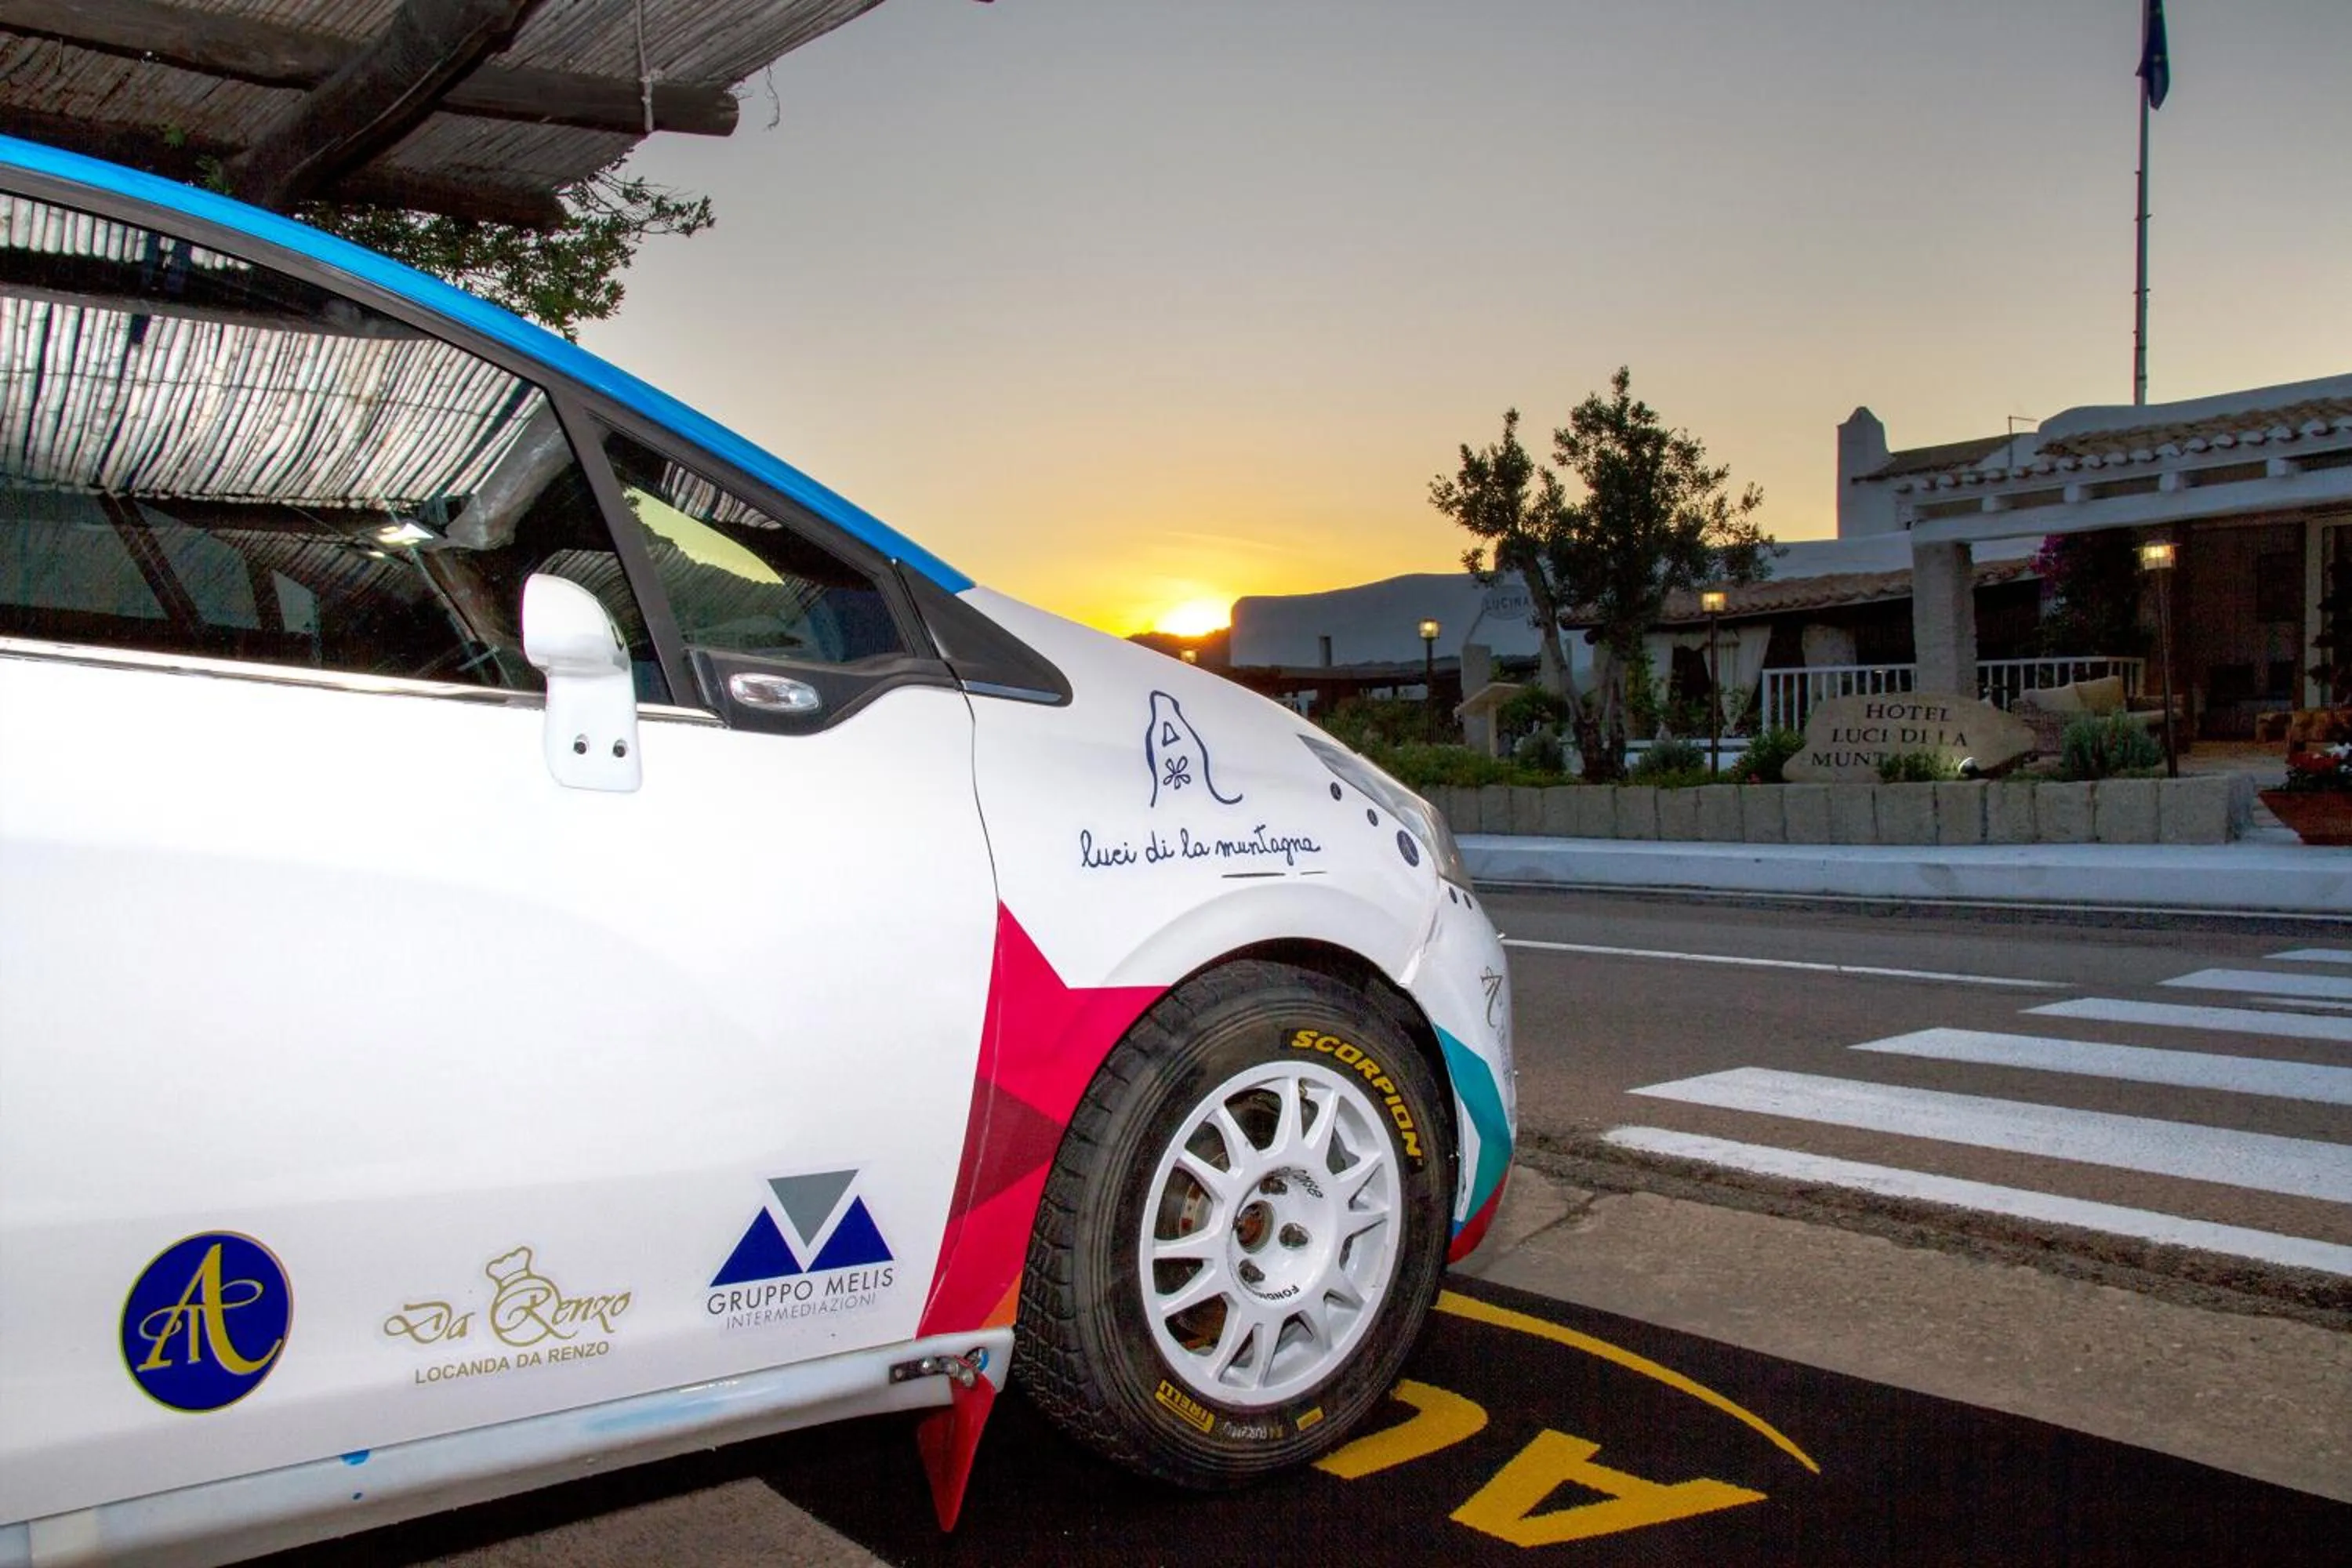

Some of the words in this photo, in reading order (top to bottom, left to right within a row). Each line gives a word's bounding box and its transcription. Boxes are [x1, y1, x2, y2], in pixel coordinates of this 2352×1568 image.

[1865, 703, 1953, 722] HOTEL
[1832, 728, 1888, 743] LUCI
[1900, 728, 1927, 744] DI
[1080, 829, 1138, 867] luci
[1145, 829, 1174, 863] di
[1180, 828, 1210, 858] la
[1215, 824, 1321, 866] muntagna
[1291, 1029, 1424, 1160] SCORPION
[383, 1301, 476, 1344] Da
[492, 1281, 632, 1342] Renzo
[707, 1280, 813, 1315] GRUPPO
[826, 1268, 894, 1296] MELIS
[726, 1293, 876, 1330] INTERMEDIAZIONI
[415, 1356, 510, 1385] LOCANDA
[516, 1351, 542, 1369] DA
[548, 1341, 610, 1363] RENZO
[1155, 1379, 1216, 1434] PIRELLI
